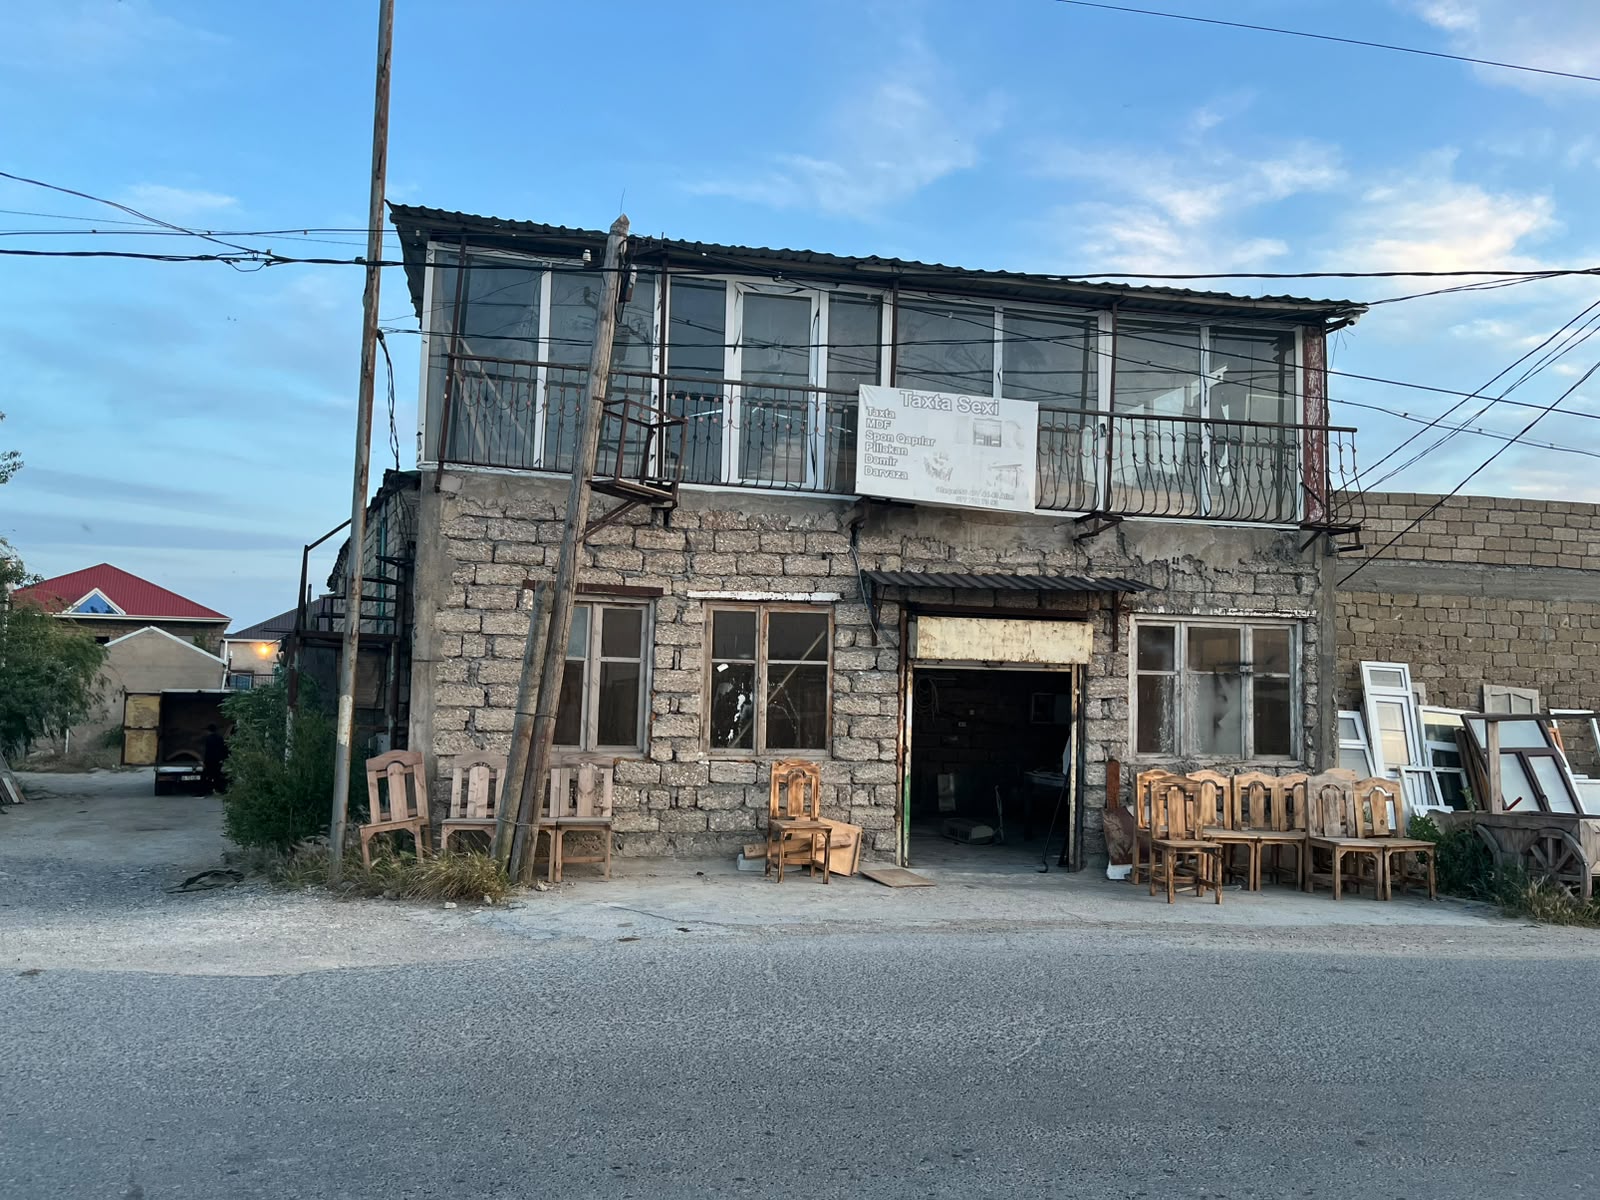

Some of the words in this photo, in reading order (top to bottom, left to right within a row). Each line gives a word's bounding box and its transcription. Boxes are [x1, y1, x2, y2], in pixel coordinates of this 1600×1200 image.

[900, 390, 952, 411] Taxta
[957, 396, 999, 416] Sexi
[866, 406, 896, 419] Taxta
[866, 418, 892, 430] MDF
[866, 430, 894, 442] Spon
[896, 433, 936, 447] Qapılar
[864, 465, 908, 480] Darvaza
